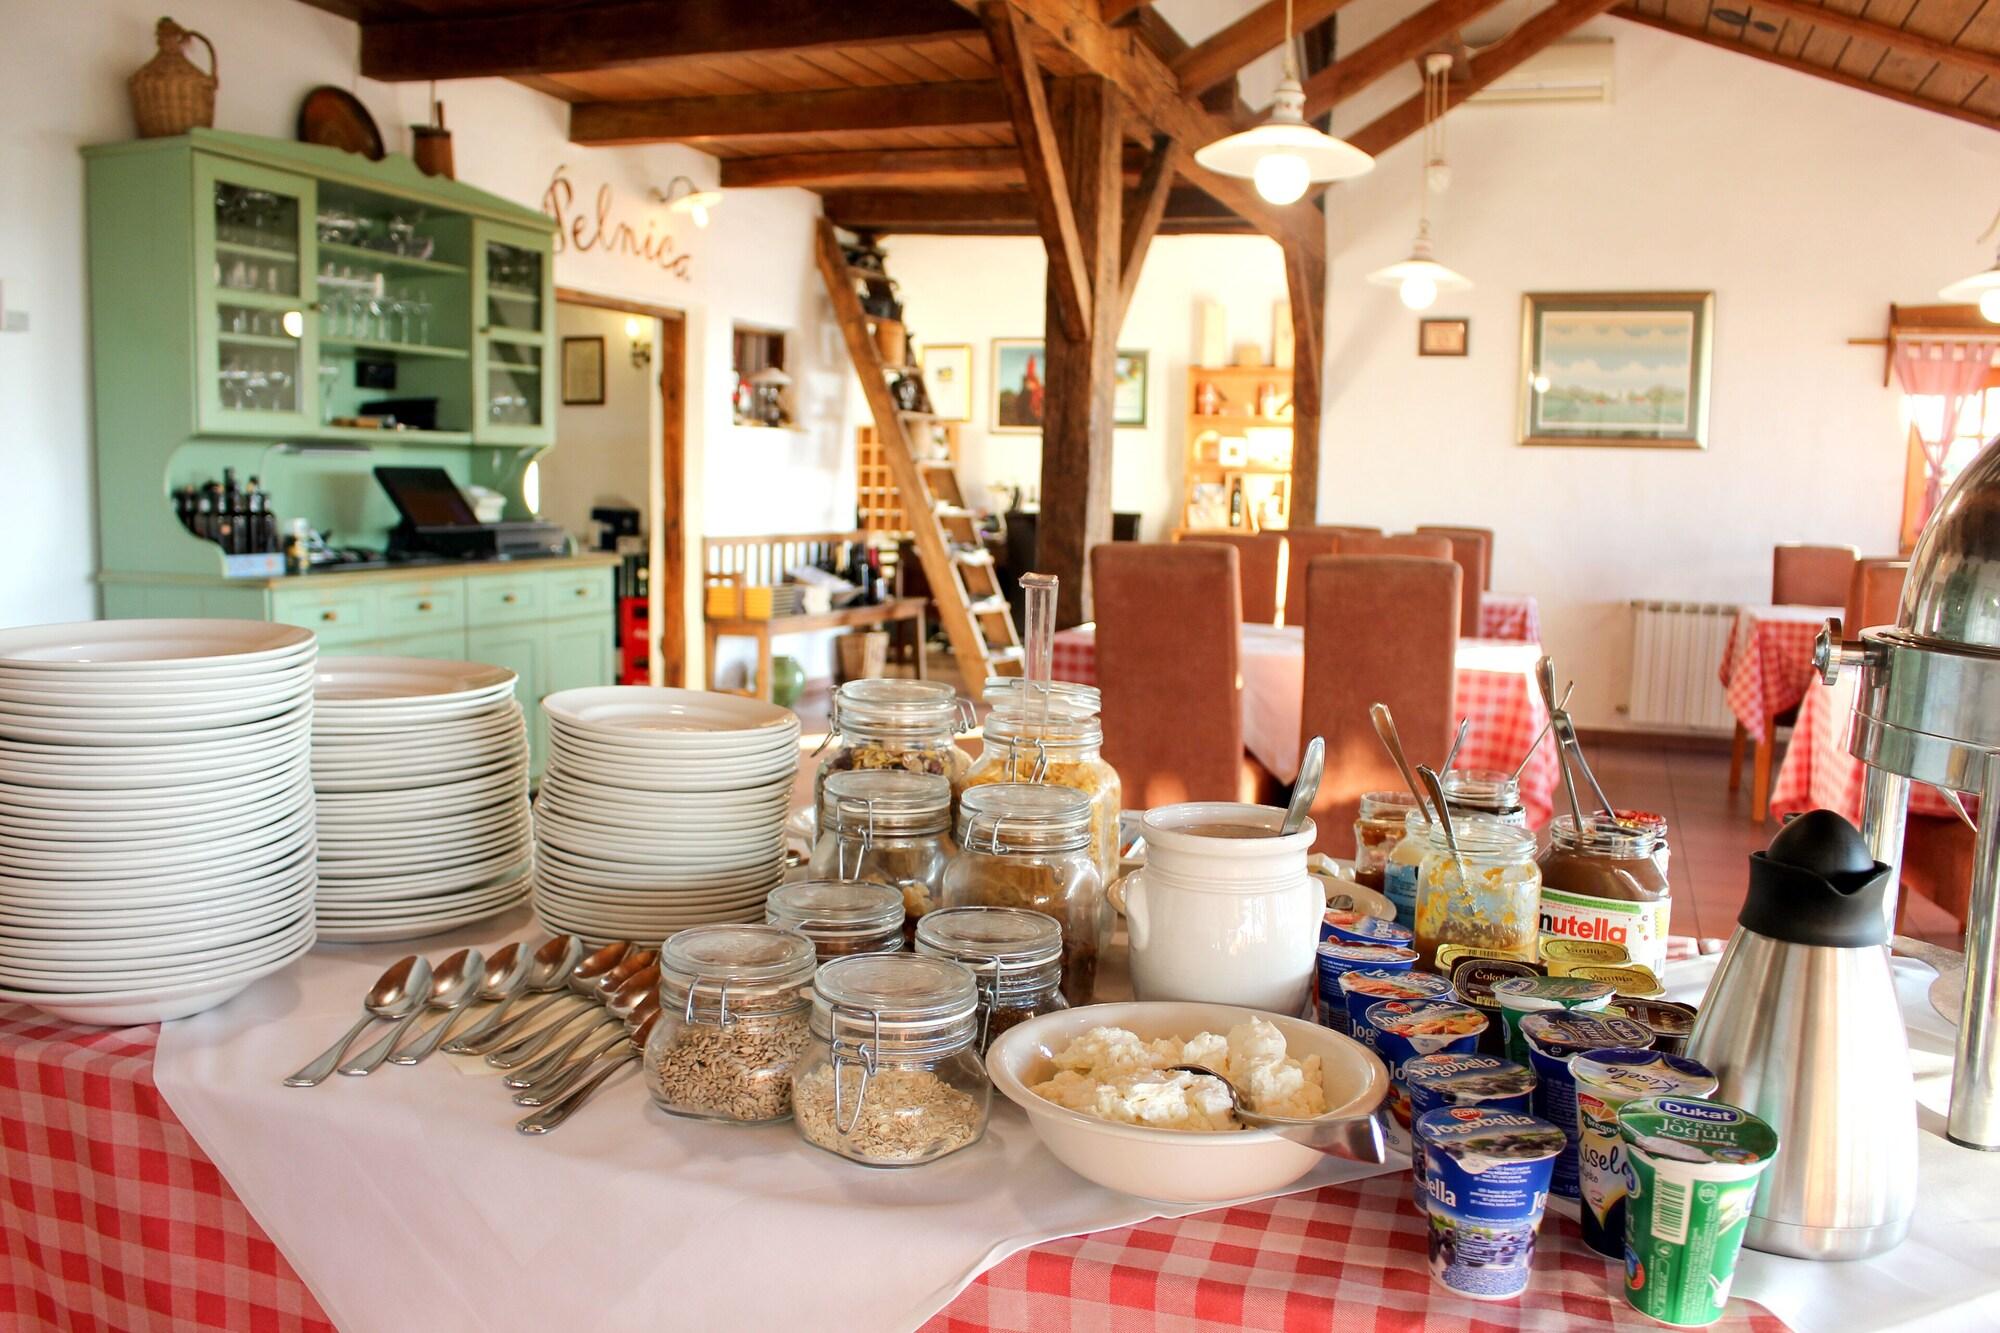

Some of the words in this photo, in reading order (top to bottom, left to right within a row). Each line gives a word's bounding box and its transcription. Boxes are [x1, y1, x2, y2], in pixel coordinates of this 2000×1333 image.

[1539, 912, 1627, 944] nutella
[1409, 1056, 1502, 1079] Jogobella
[1664, 1102, 1732, 1121] Dukat
[1424, 1113, 1536, 1136] Jogobella
[1655, 1118, 1737, 1141] Jogurt
